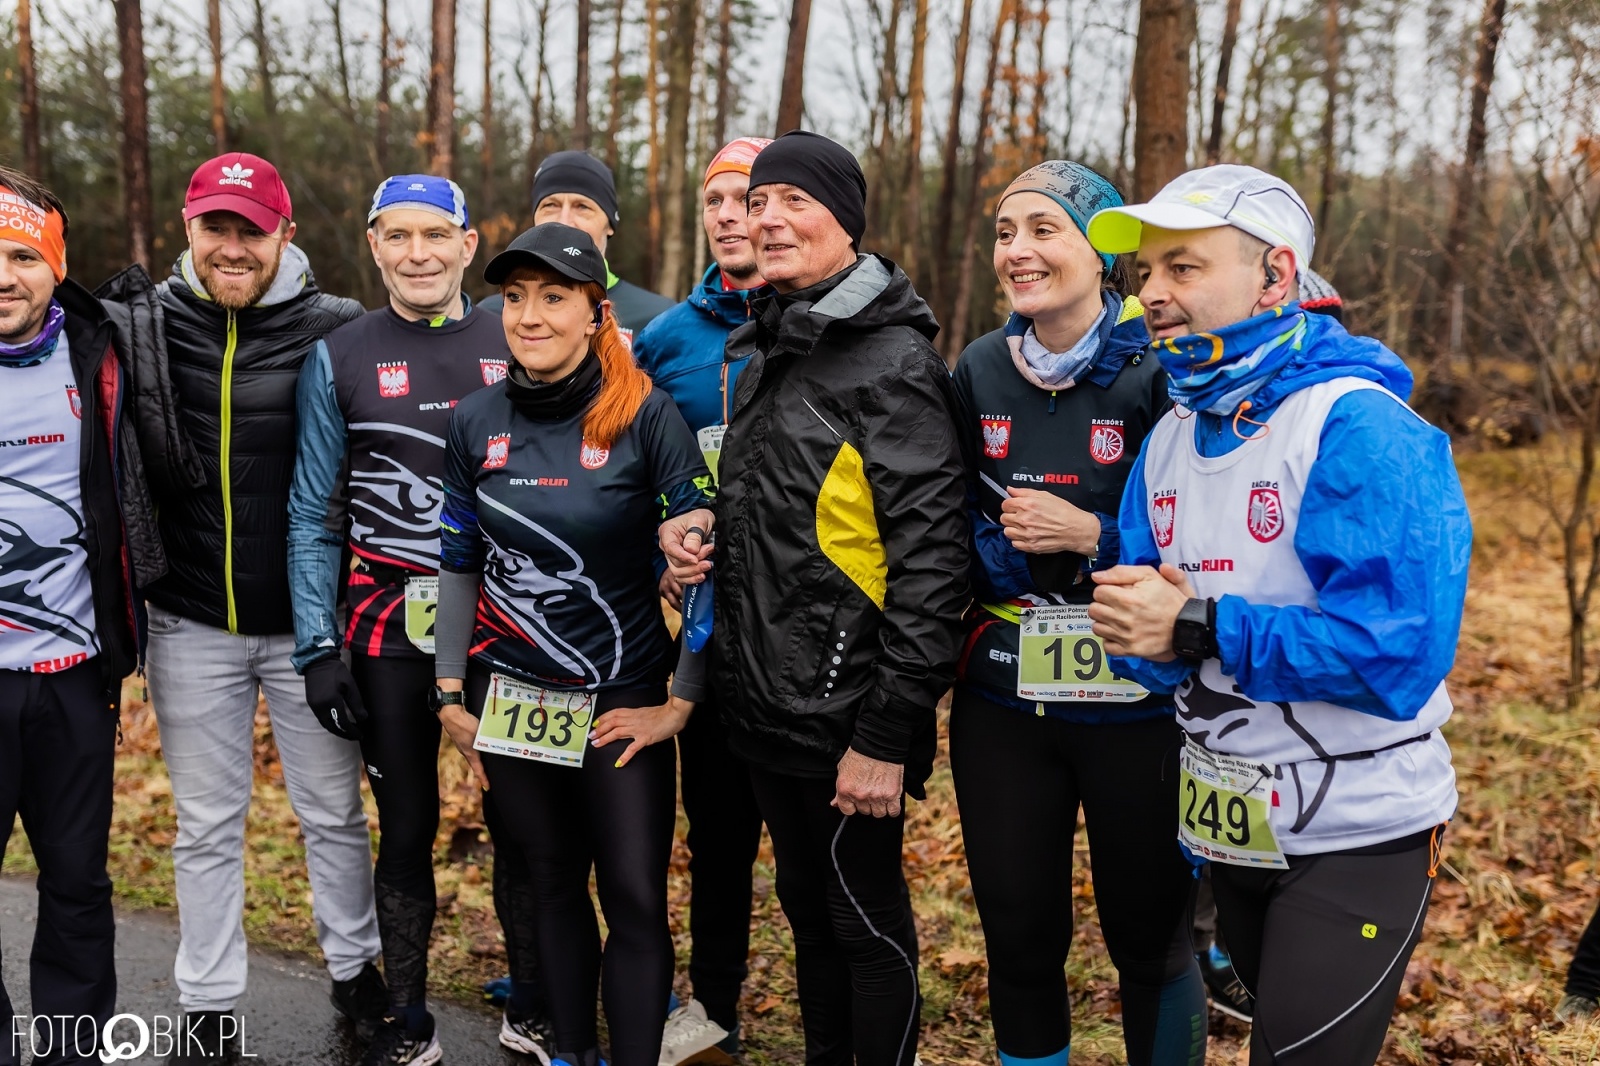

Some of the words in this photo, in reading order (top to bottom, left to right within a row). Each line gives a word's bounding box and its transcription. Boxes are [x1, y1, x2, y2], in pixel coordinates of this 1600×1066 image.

[218, 177, 252, 189] adidas
[563, 246, 582, 257] 4F
[1091, 418, 1124, 426] RACIBÓRZ
[424, 603, 438, 636] 2
[1043, 637, 1121, 681] 19
[503, 703, 574, 747] 193
[1184, 778, 1250, 847] 249
